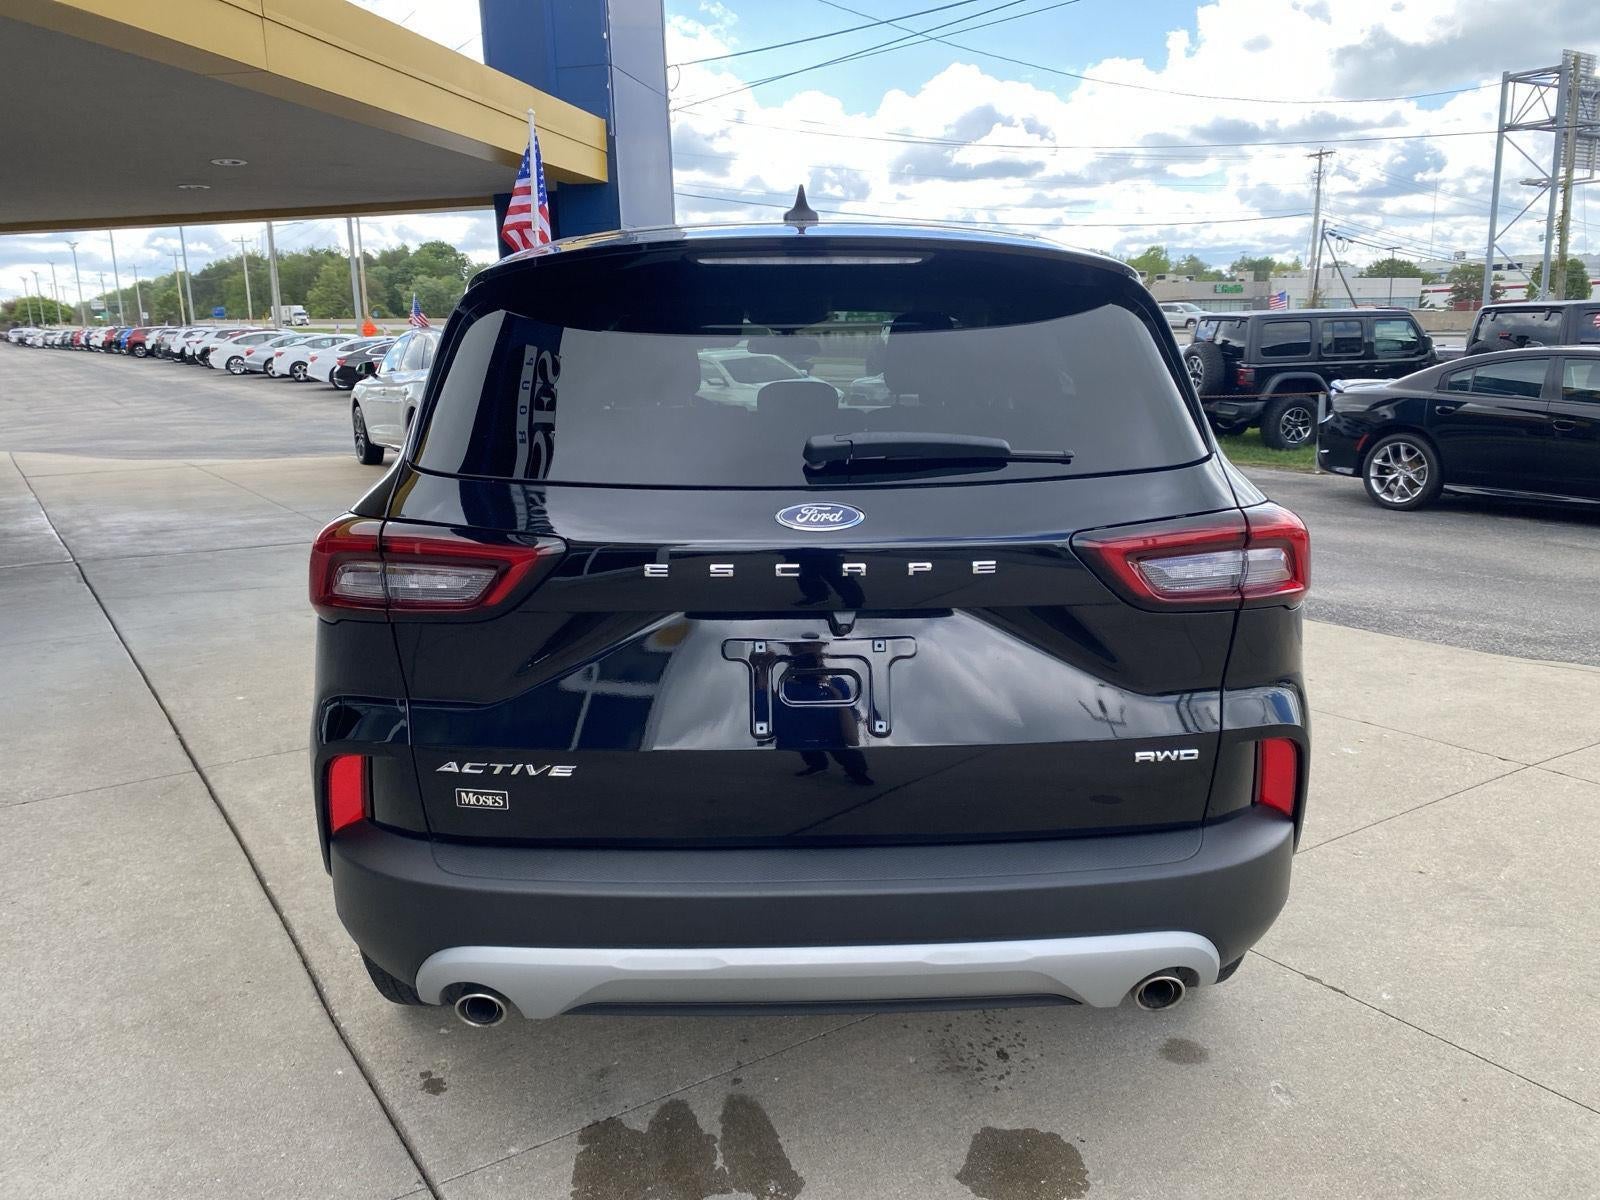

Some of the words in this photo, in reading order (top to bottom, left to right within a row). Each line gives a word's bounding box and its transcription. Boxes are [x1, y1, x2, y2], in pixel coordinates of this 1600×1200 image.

[796, 506, 843, 523] Ford
[644, 560, 997, 577] ESCAPE
[1134, 749, 1200, 763] AWD
[435, 761, 577, 777] ACTIVE
